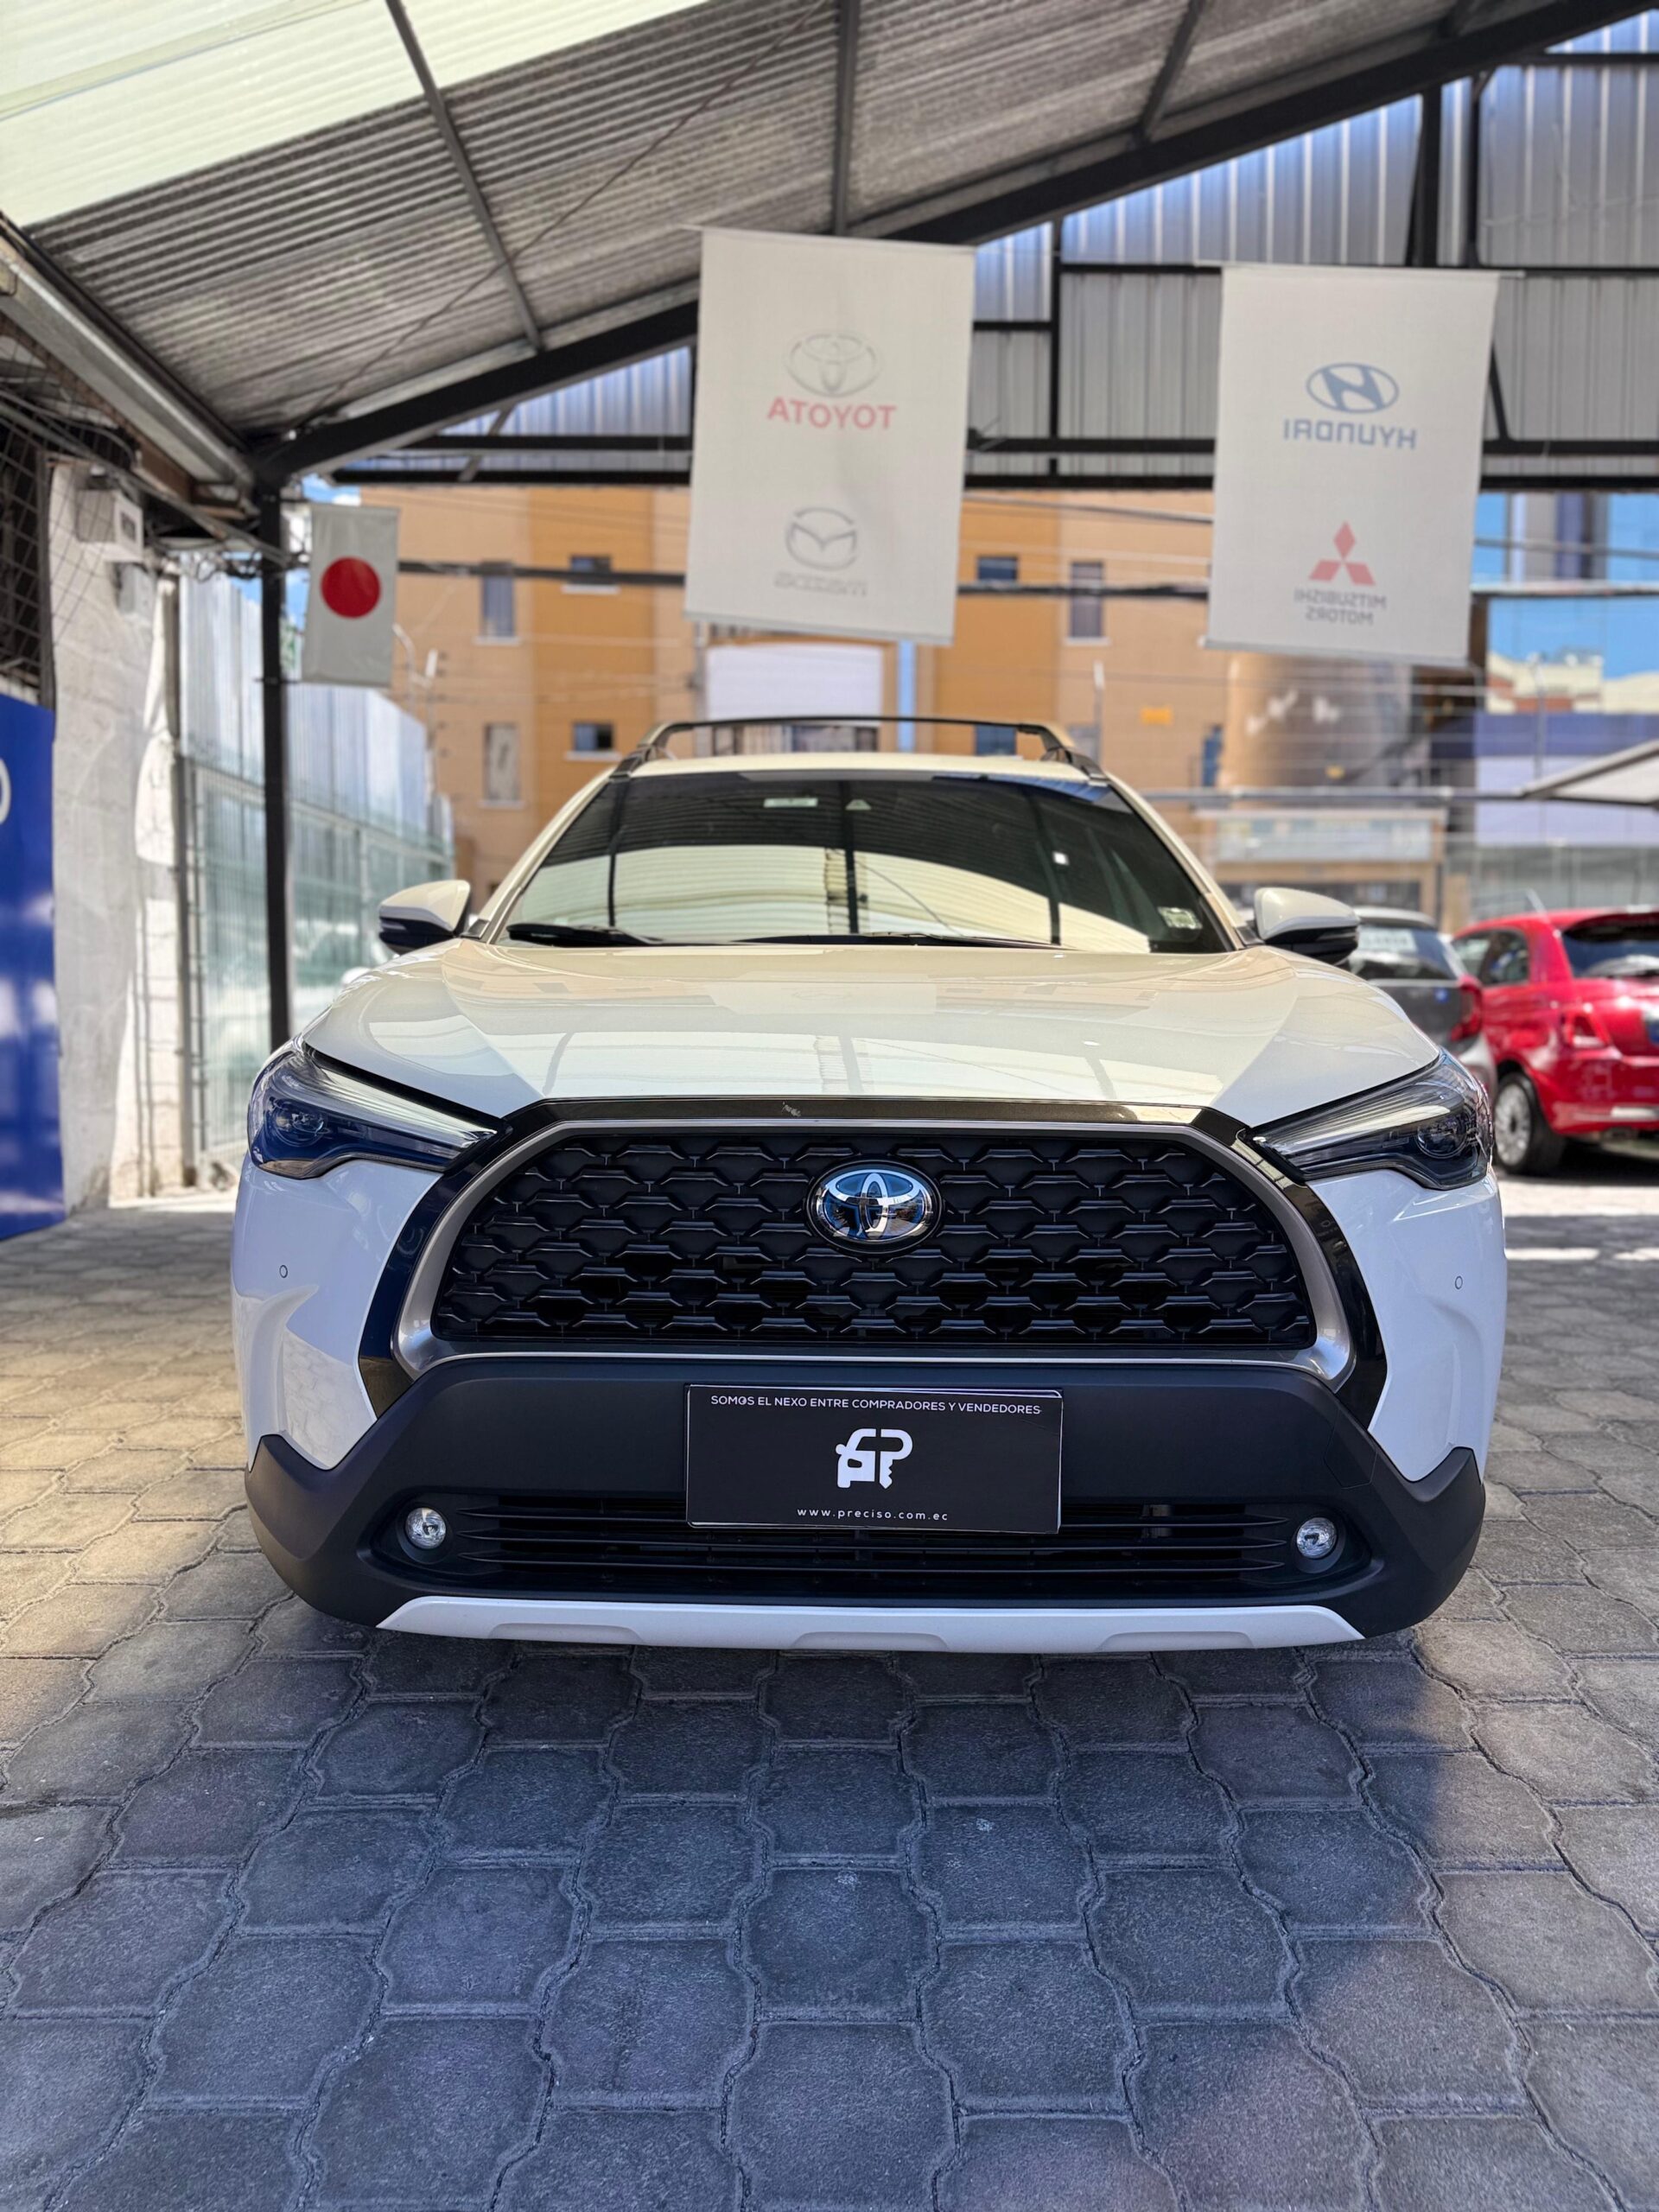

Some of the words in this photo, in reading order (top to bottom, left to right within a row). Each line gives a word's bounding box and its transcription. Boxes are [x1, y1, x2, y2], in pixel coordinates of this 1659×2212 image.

[710, 1395, 755, 1406] SOMOS
[757, 1396, 772, 1407] EL
[774, 1397, 807, 1407] NEXO
[810, 1398, 849, 1408] ENTRE
[851, 1399, 946, 1411] COMPRADORES
[948, 1402, 957, 1412] Y
[957, 1403, 1041, 1414] VENDEDORES
[797, 1509, 948, 1521] www.preciso.com.ec
